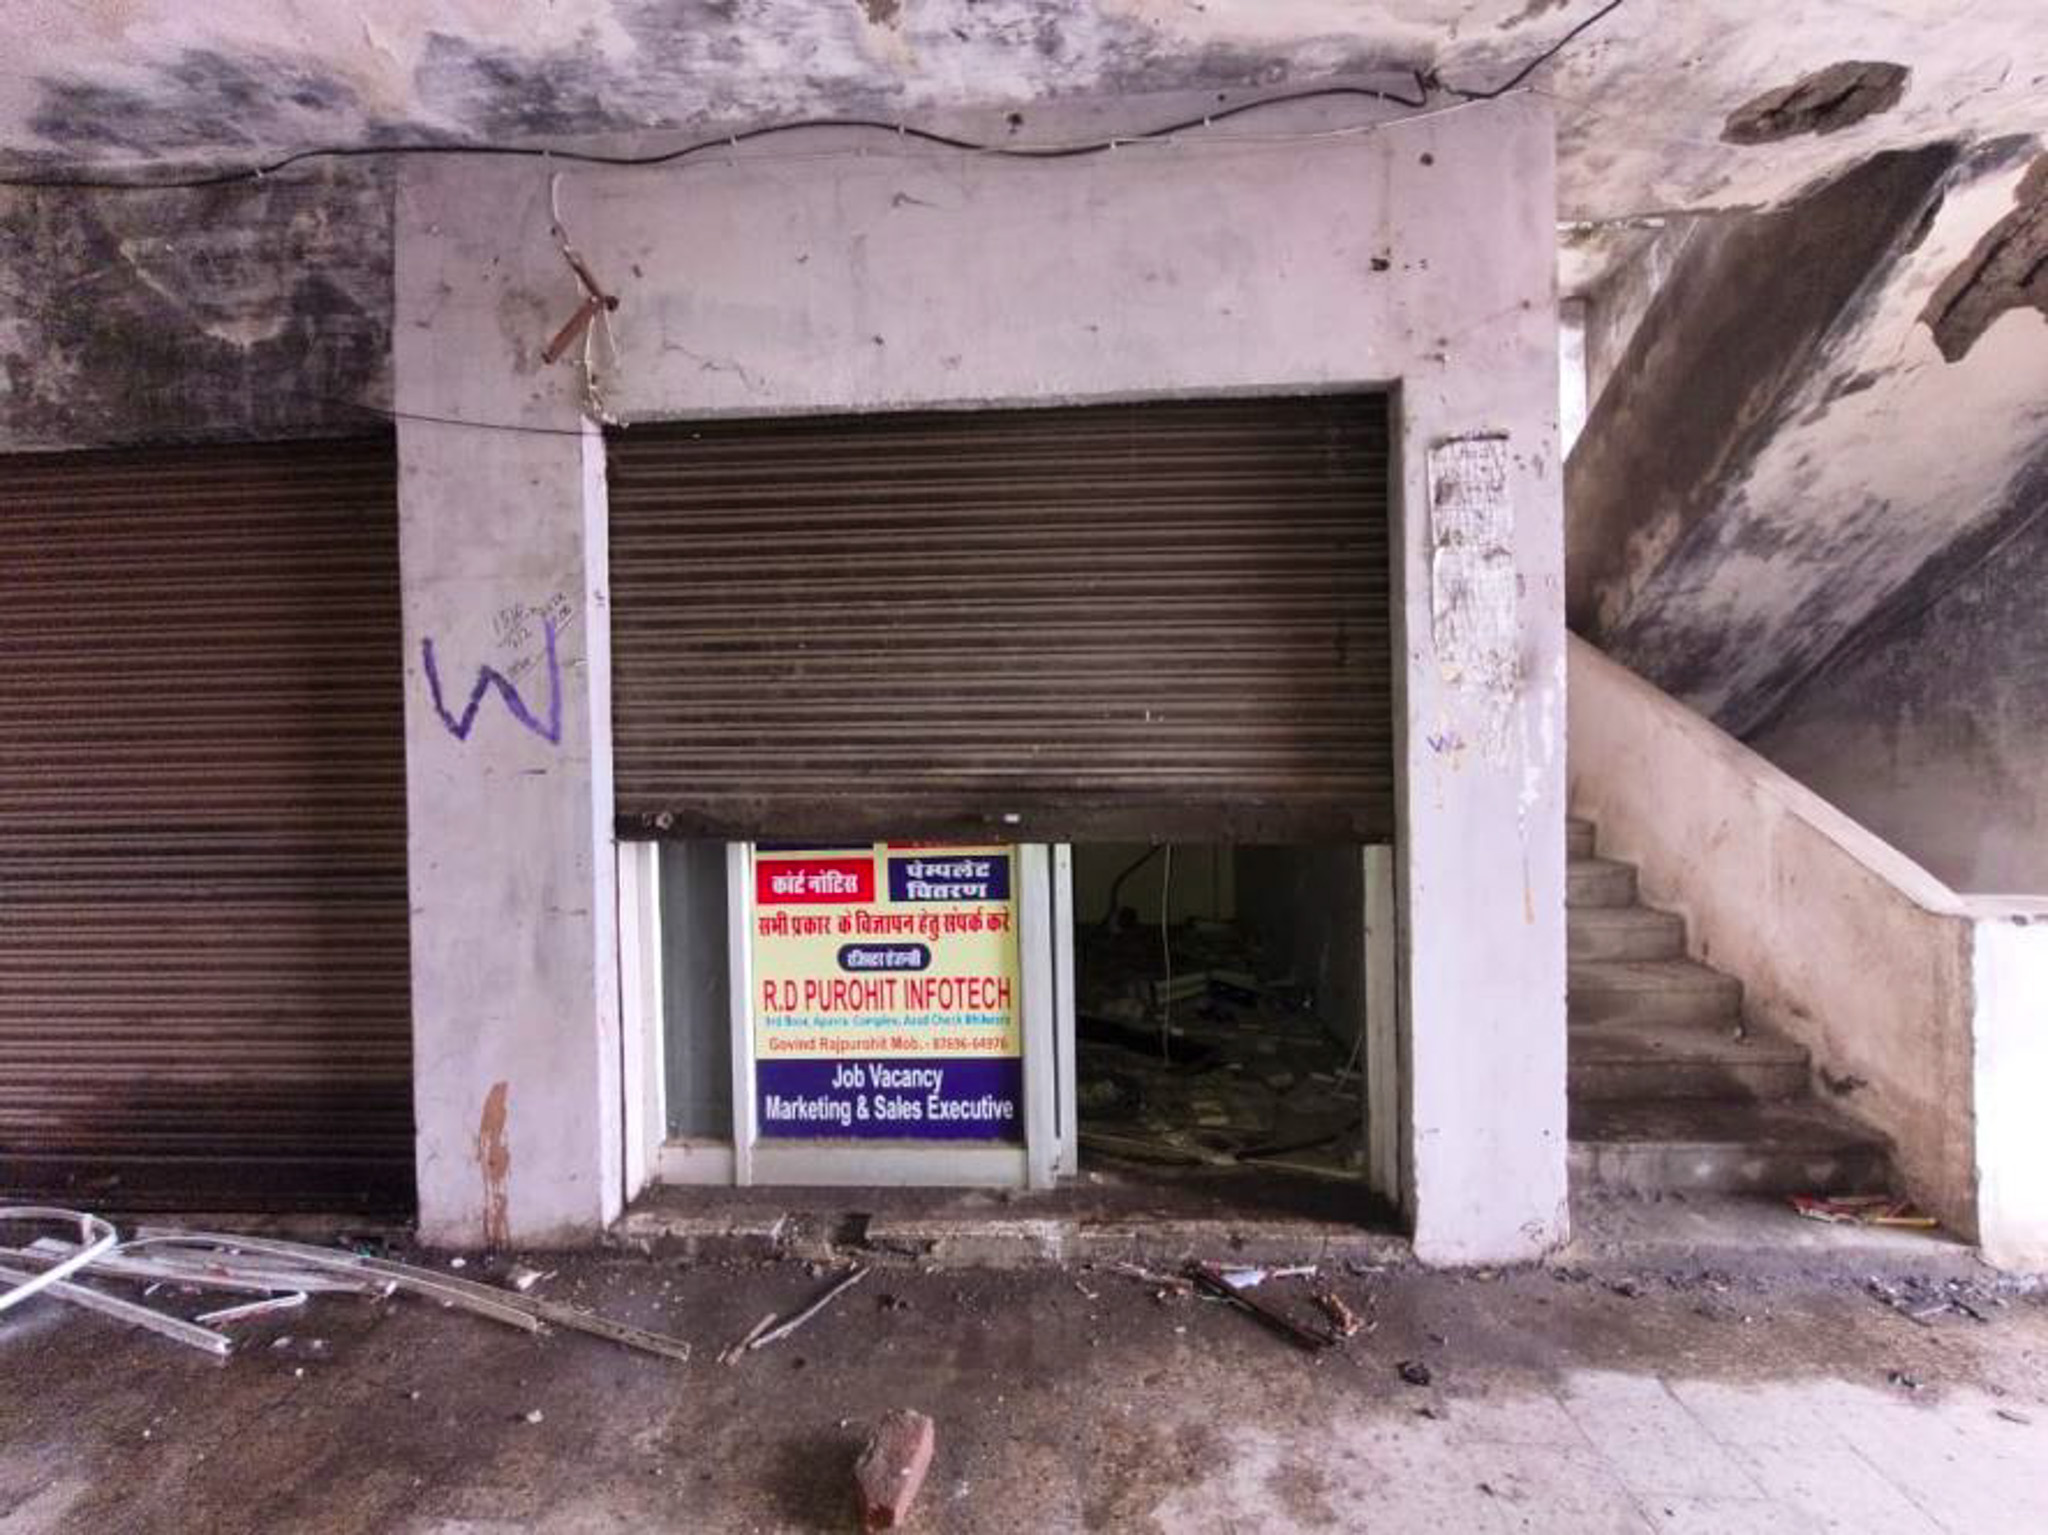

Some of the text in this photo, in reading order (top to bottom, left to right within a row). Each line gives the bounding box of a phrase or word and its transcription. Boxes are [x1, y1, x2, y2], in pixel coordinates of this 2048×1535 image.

[421, 616, 561, 745] W
[906, 880, 988, 898] वितरण
[758, 910, 788, 936] सभी
[792, 915, 831, 937] प्रकार
[764, 977, 1012, 1012] R.D PUROHIT INFOTECH
[831, 1063, 944, 1093] Job Vacancy
[766, 1095, 1014, 1126] Marketing & Sales Executive
